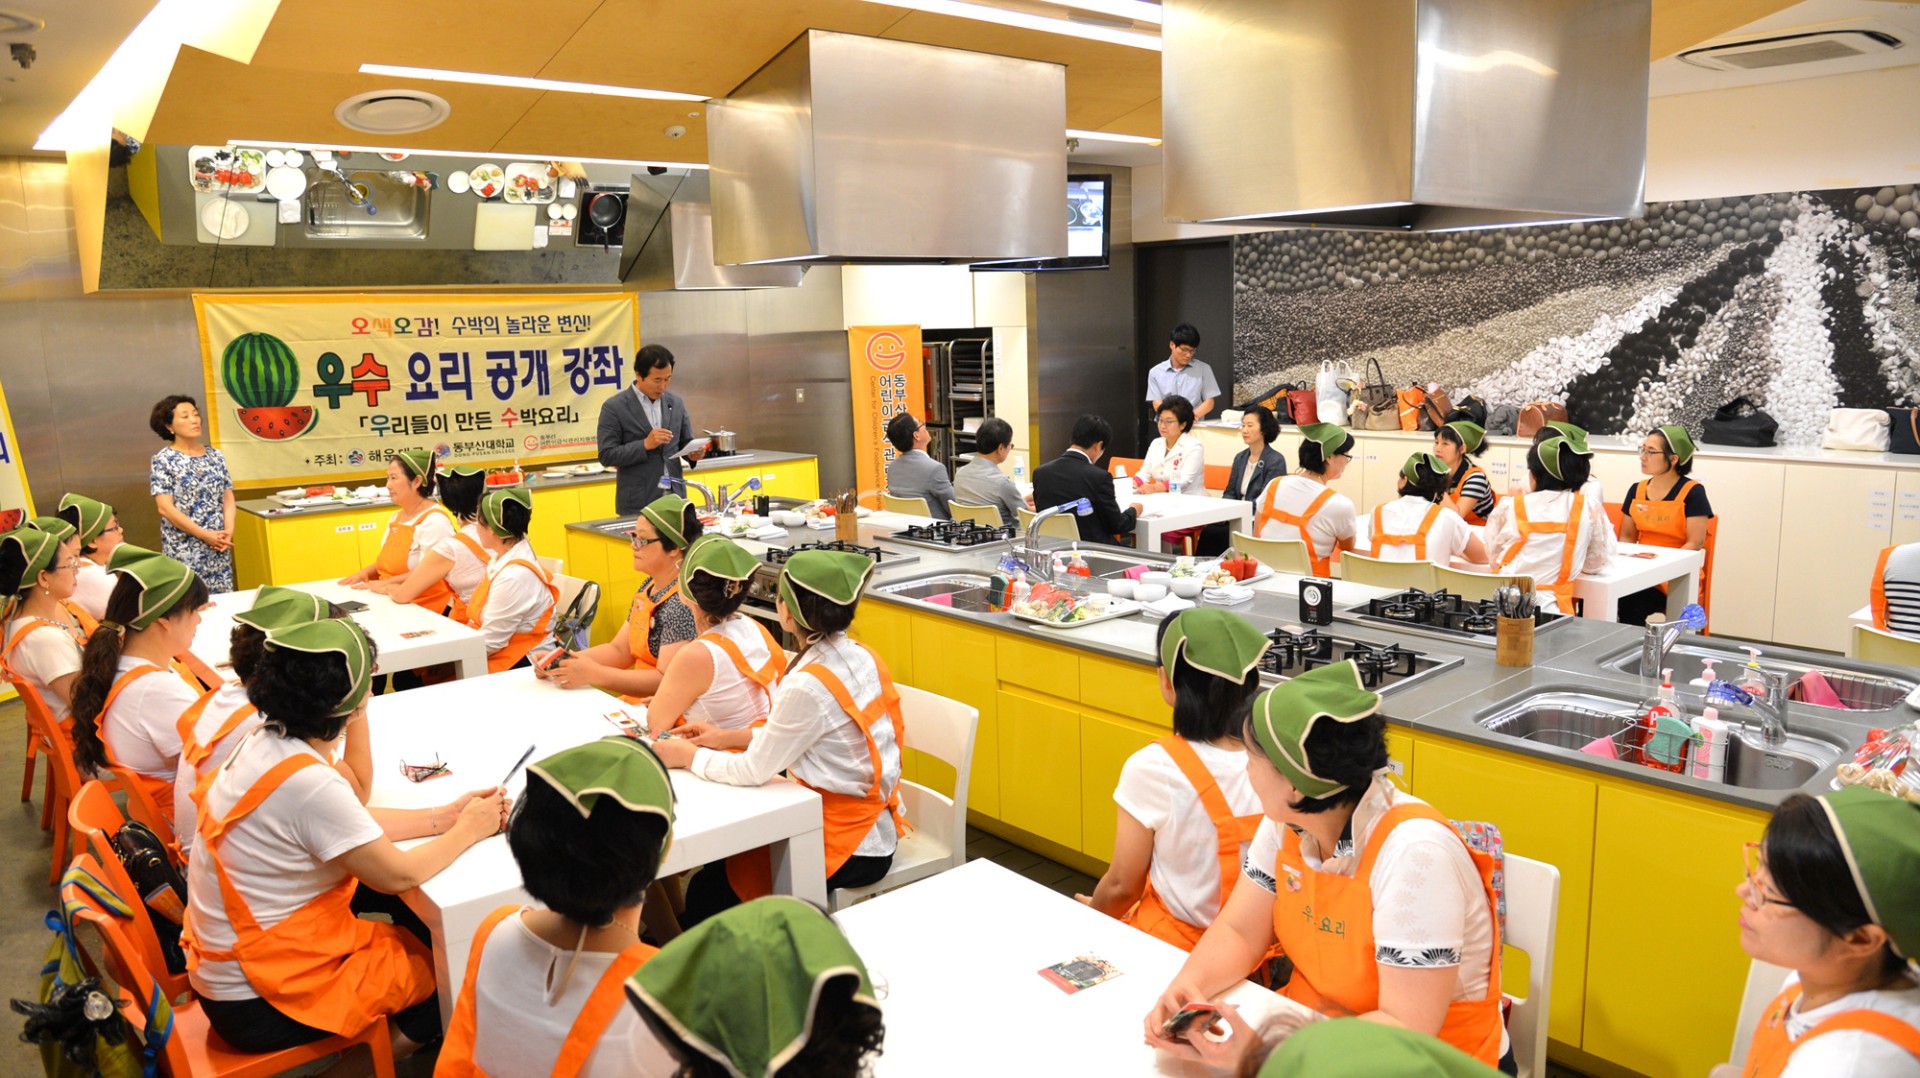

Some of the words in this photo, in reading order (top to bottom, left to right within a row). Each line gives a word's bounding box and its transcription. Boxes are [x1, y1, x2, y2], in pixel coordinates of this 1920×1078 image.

[351, 317, 440, 338] 오색오감!
[451, 316, 500, 335] 수박의
[506, 315, 551, 334] 놀라운
[557, 314, 591, 333] 변신!
[313, 352, 391, 409] 우수
[405, 351, 473, 401] 요리
[486, 349, 550, 401] 공개
[562, 345, 623, 395] 강좌
[455, 411, 493, 431] 만든
[453, 438, 515, 453] 동부산대학교
